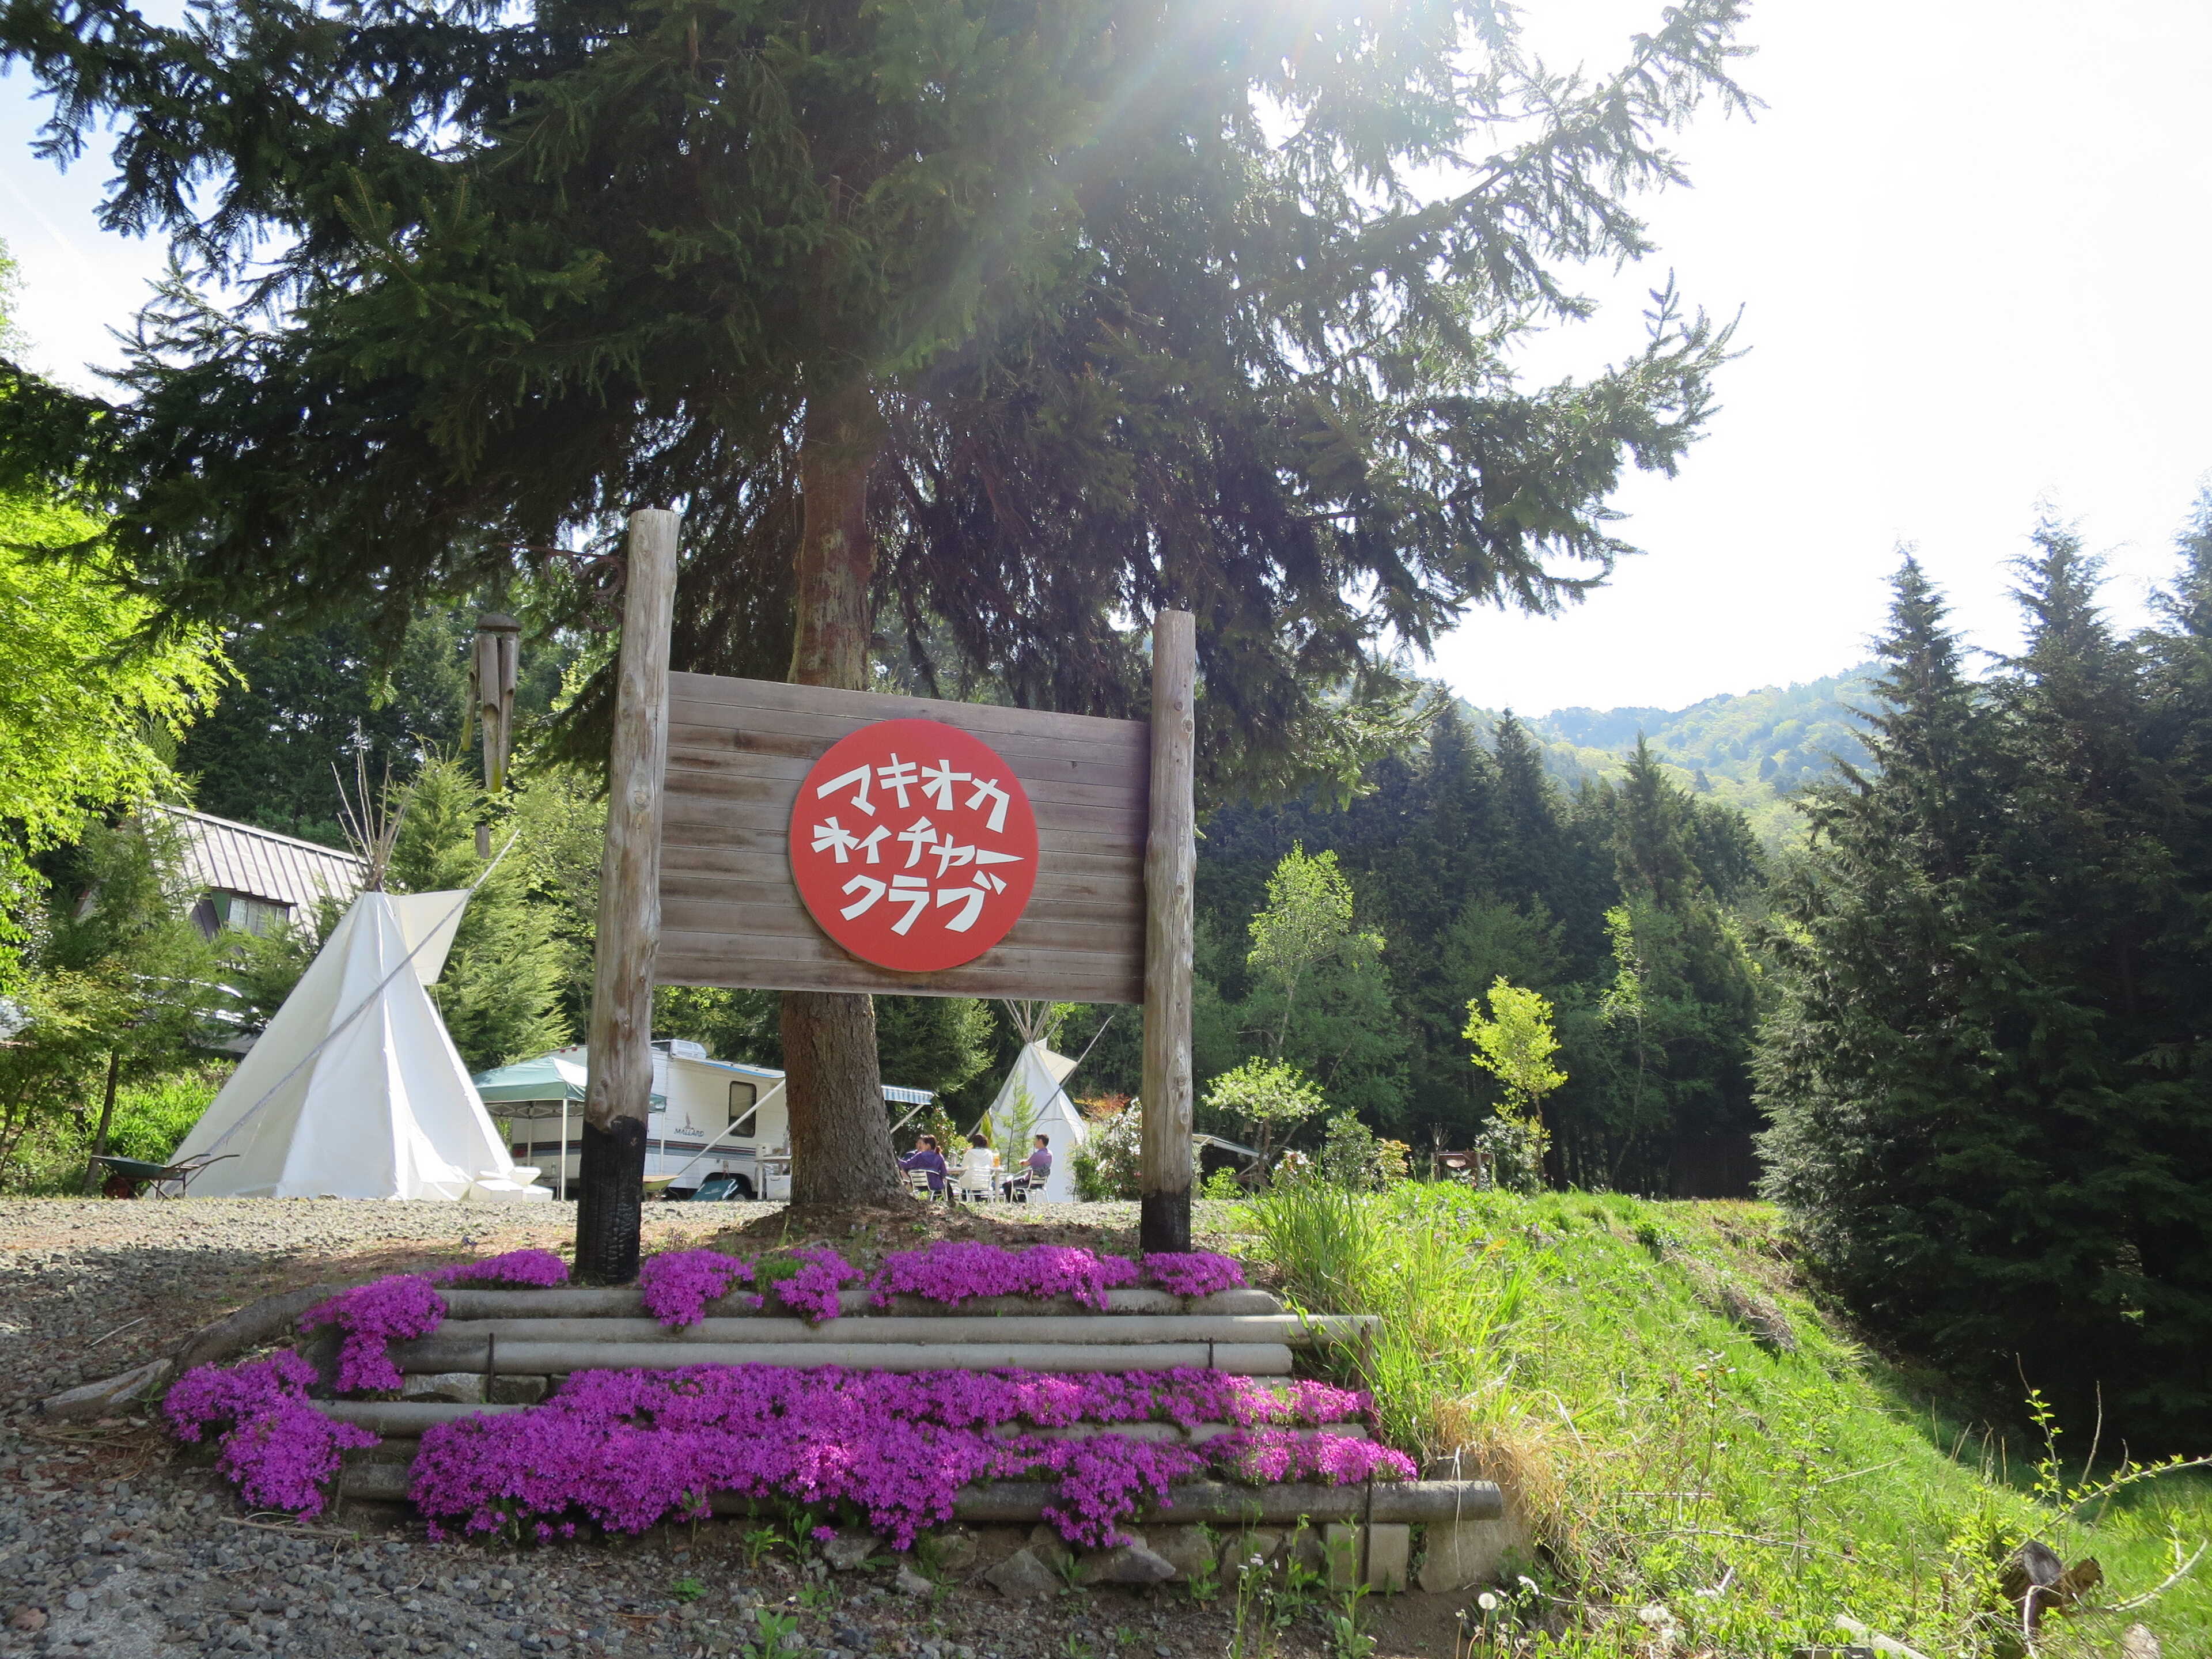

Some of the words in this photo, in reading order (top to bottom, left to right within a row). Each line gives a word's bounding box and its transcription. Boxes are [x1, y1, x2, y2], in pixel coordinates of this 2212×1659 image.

[816, 752, 1010, 833] マキオカ
[811, 816, 1025, 879] ネイチャー
[839, 870, 1007, 936] クラブ
[674, 1128, 704, 1137] MALLARD
